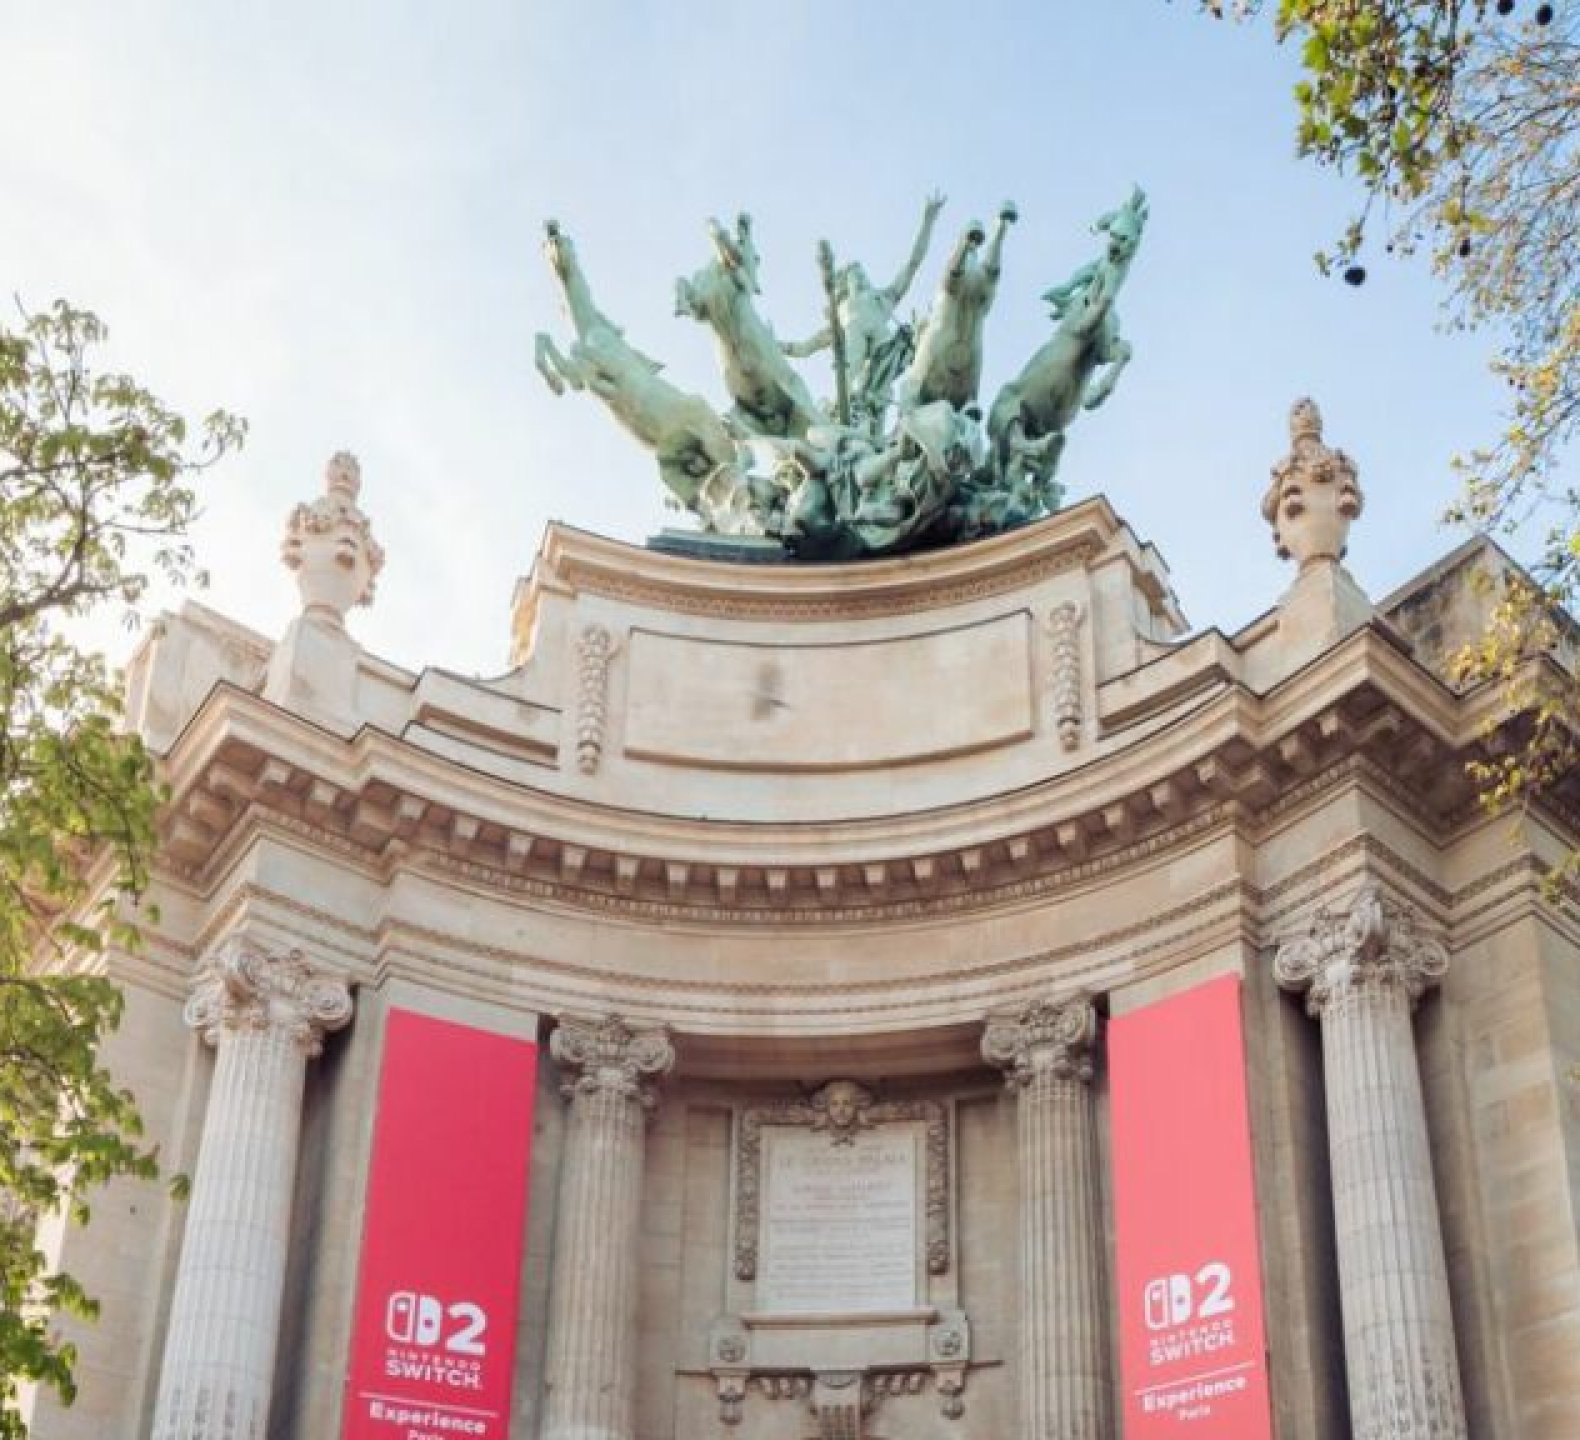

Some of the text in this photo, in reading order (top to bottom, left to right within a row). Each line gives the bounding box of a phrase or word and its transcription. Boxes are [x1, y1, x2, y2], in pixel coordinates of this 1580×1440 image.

[1196, 1262, 1235, 1318] 2
[445, 1301, 488, 1356] 2
[1150, 1329, 1233, 1366] SWITCH
[385, 1359, 482, 1390] SWITCH
[1144, 1376, 1246, 1412] Experience
[369, 1400, 487, 1435] Experience
